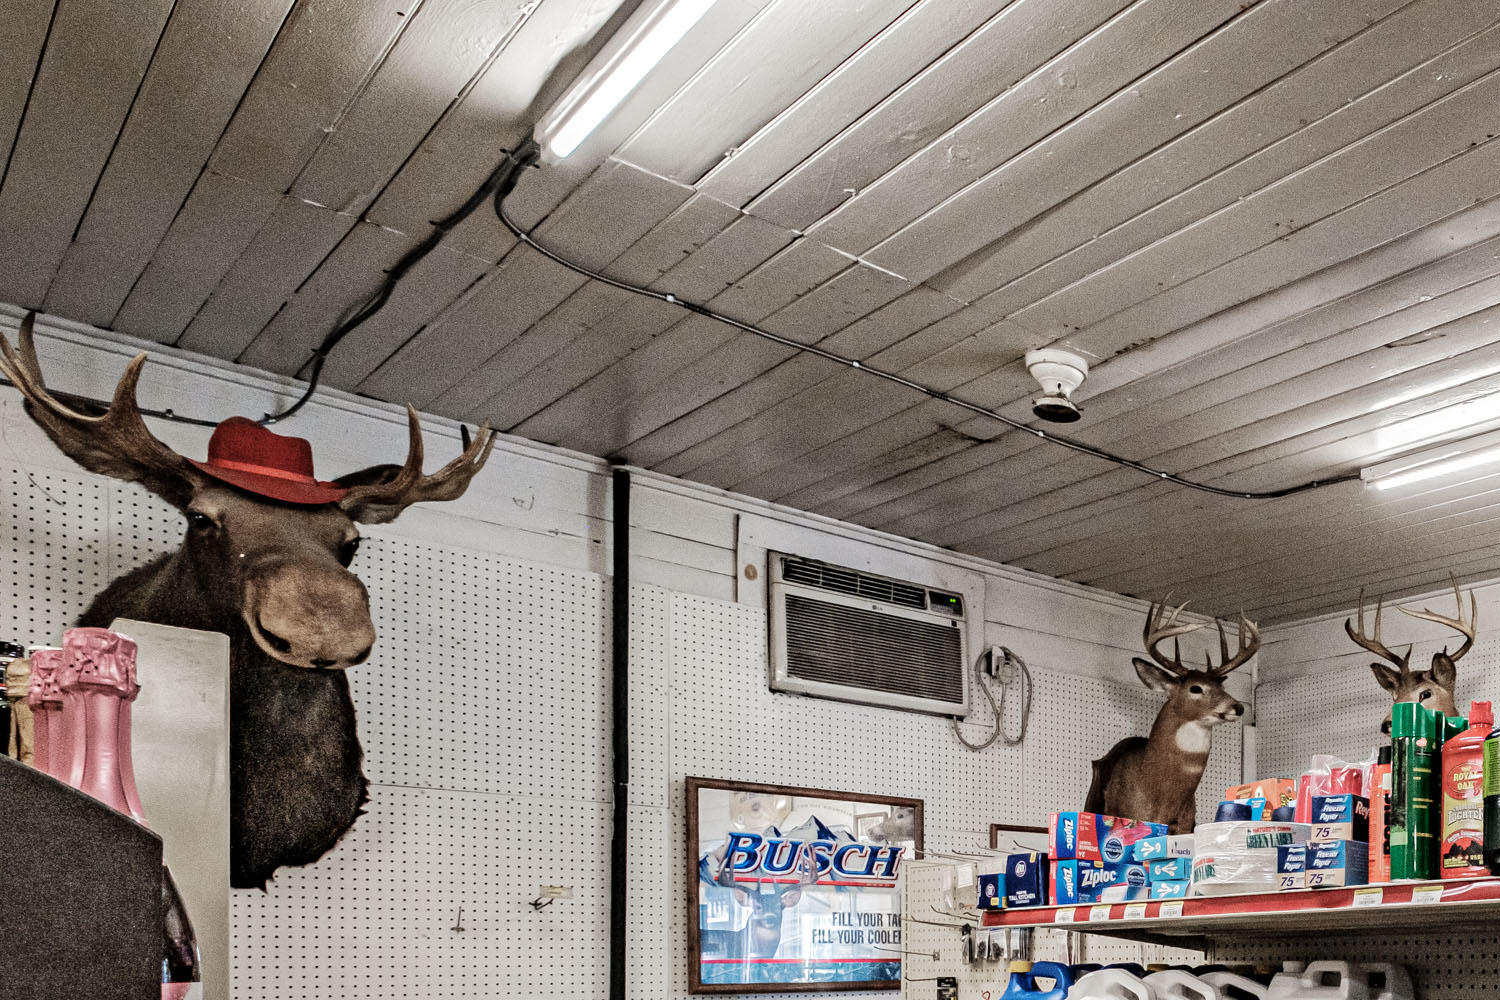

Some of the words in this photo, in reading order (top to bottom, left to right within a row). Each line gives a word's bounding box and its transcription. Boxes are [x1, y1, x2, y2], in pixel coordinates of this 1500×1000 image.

[1063, 818, 1075, 851] Ziploc
[1315, 827, 1331, 838] 75
[727, 832, 906, 879] BUSCH
[1062, 867, 1074, 899] Ziploc
[1081, 869, 1117, 889] Ziploc
[1280, 877, 1295, 887] 75
[1309, 873, 1324, 884] 75
[832, 912, 854, 927] FILL
[856, 912, 883, 927] YOUR
[812, 929, 833, 944] FILL
[837, 929, 864, 944] YOUR
